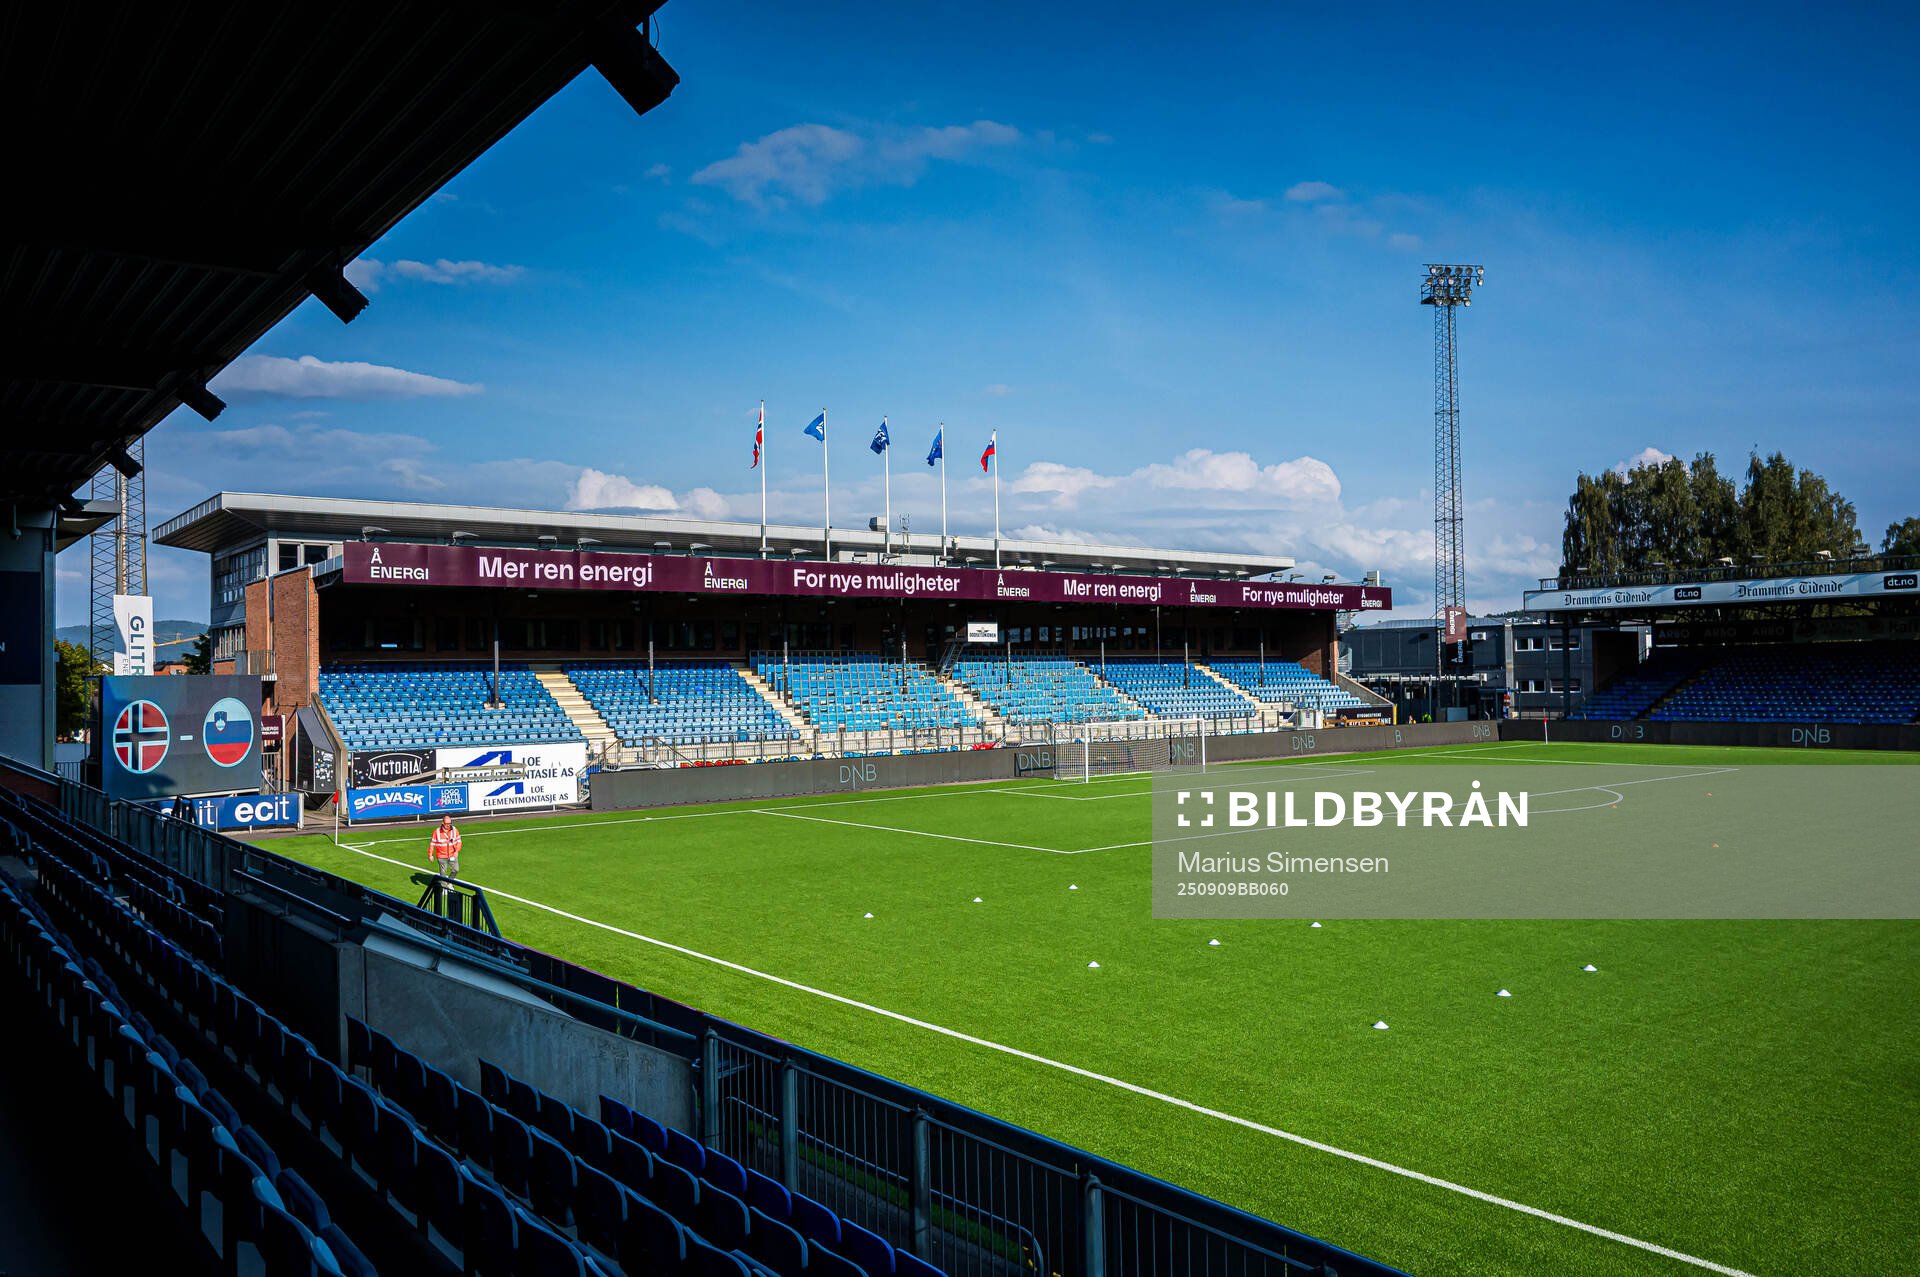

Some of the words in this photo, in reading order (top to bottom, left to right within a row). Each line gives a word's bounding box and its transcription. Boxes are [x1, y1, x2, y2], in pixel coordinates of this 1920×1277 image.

[371, 547, 382, 564] Å
[370, 567, 429, 580] ENERGI
[479, 556, 528, 578] Mer
[535, 561, 574, 580] ren
[580, 562, 652, 587] energi
[704, 561, 713, 576] Å
[704, 577, 748, 590] ENERGI
[793, 568, 827, 588] For
[830, 574, 862, 593] nye
[867, 571, 960, 595] muligheter
[997, 573, 1005, 586] Å
[1888, 576, 1915, 588] dt.no
[997, 586, 1030, 597] ENERGI
[1063, 579, 1093, 597] Mer
[1094, 583, 1117, 597] ren
[1119, 583, 1162, 601] energi
[1190, 582, 1196, 594] Å
[1361, 589, 1366, 600] Å
[1677, 588, 1699, 599] dt.no
[1738, 583, 1795, 598] Drammens
[1798, 580, 1844, 595] Tidende
[1190, 593, 1217, 603] ENERGI
[1243, 586, 1263, 602] For
[1264, 589, 1284, 604] nye
[1286, 588, 1344, 606] muligheter
[1564, 593, 1612, 606] Drammens
[1615, 591, 1652, 605] Tidende
[1361, 600, 1382, 608] ENERGI
[1292, 731, 1316, 755] DNB
[1791, 724, 1831, 747] DNB
[371, 758, 420, 777] VICTORIA
[1018, 746, 1051, 774] DNB
[561, 767, 574, 777] AS
[839, 758, 877, 789] DNB
[530, 785, 545, 793] LOE
[354, 791, 425, 811] SOLVASK
[483, 793, 556, 807] ELEMENTMONTASJE
[558, 792, 569, 801] AS
[234, 796, 290, 823] ecit
